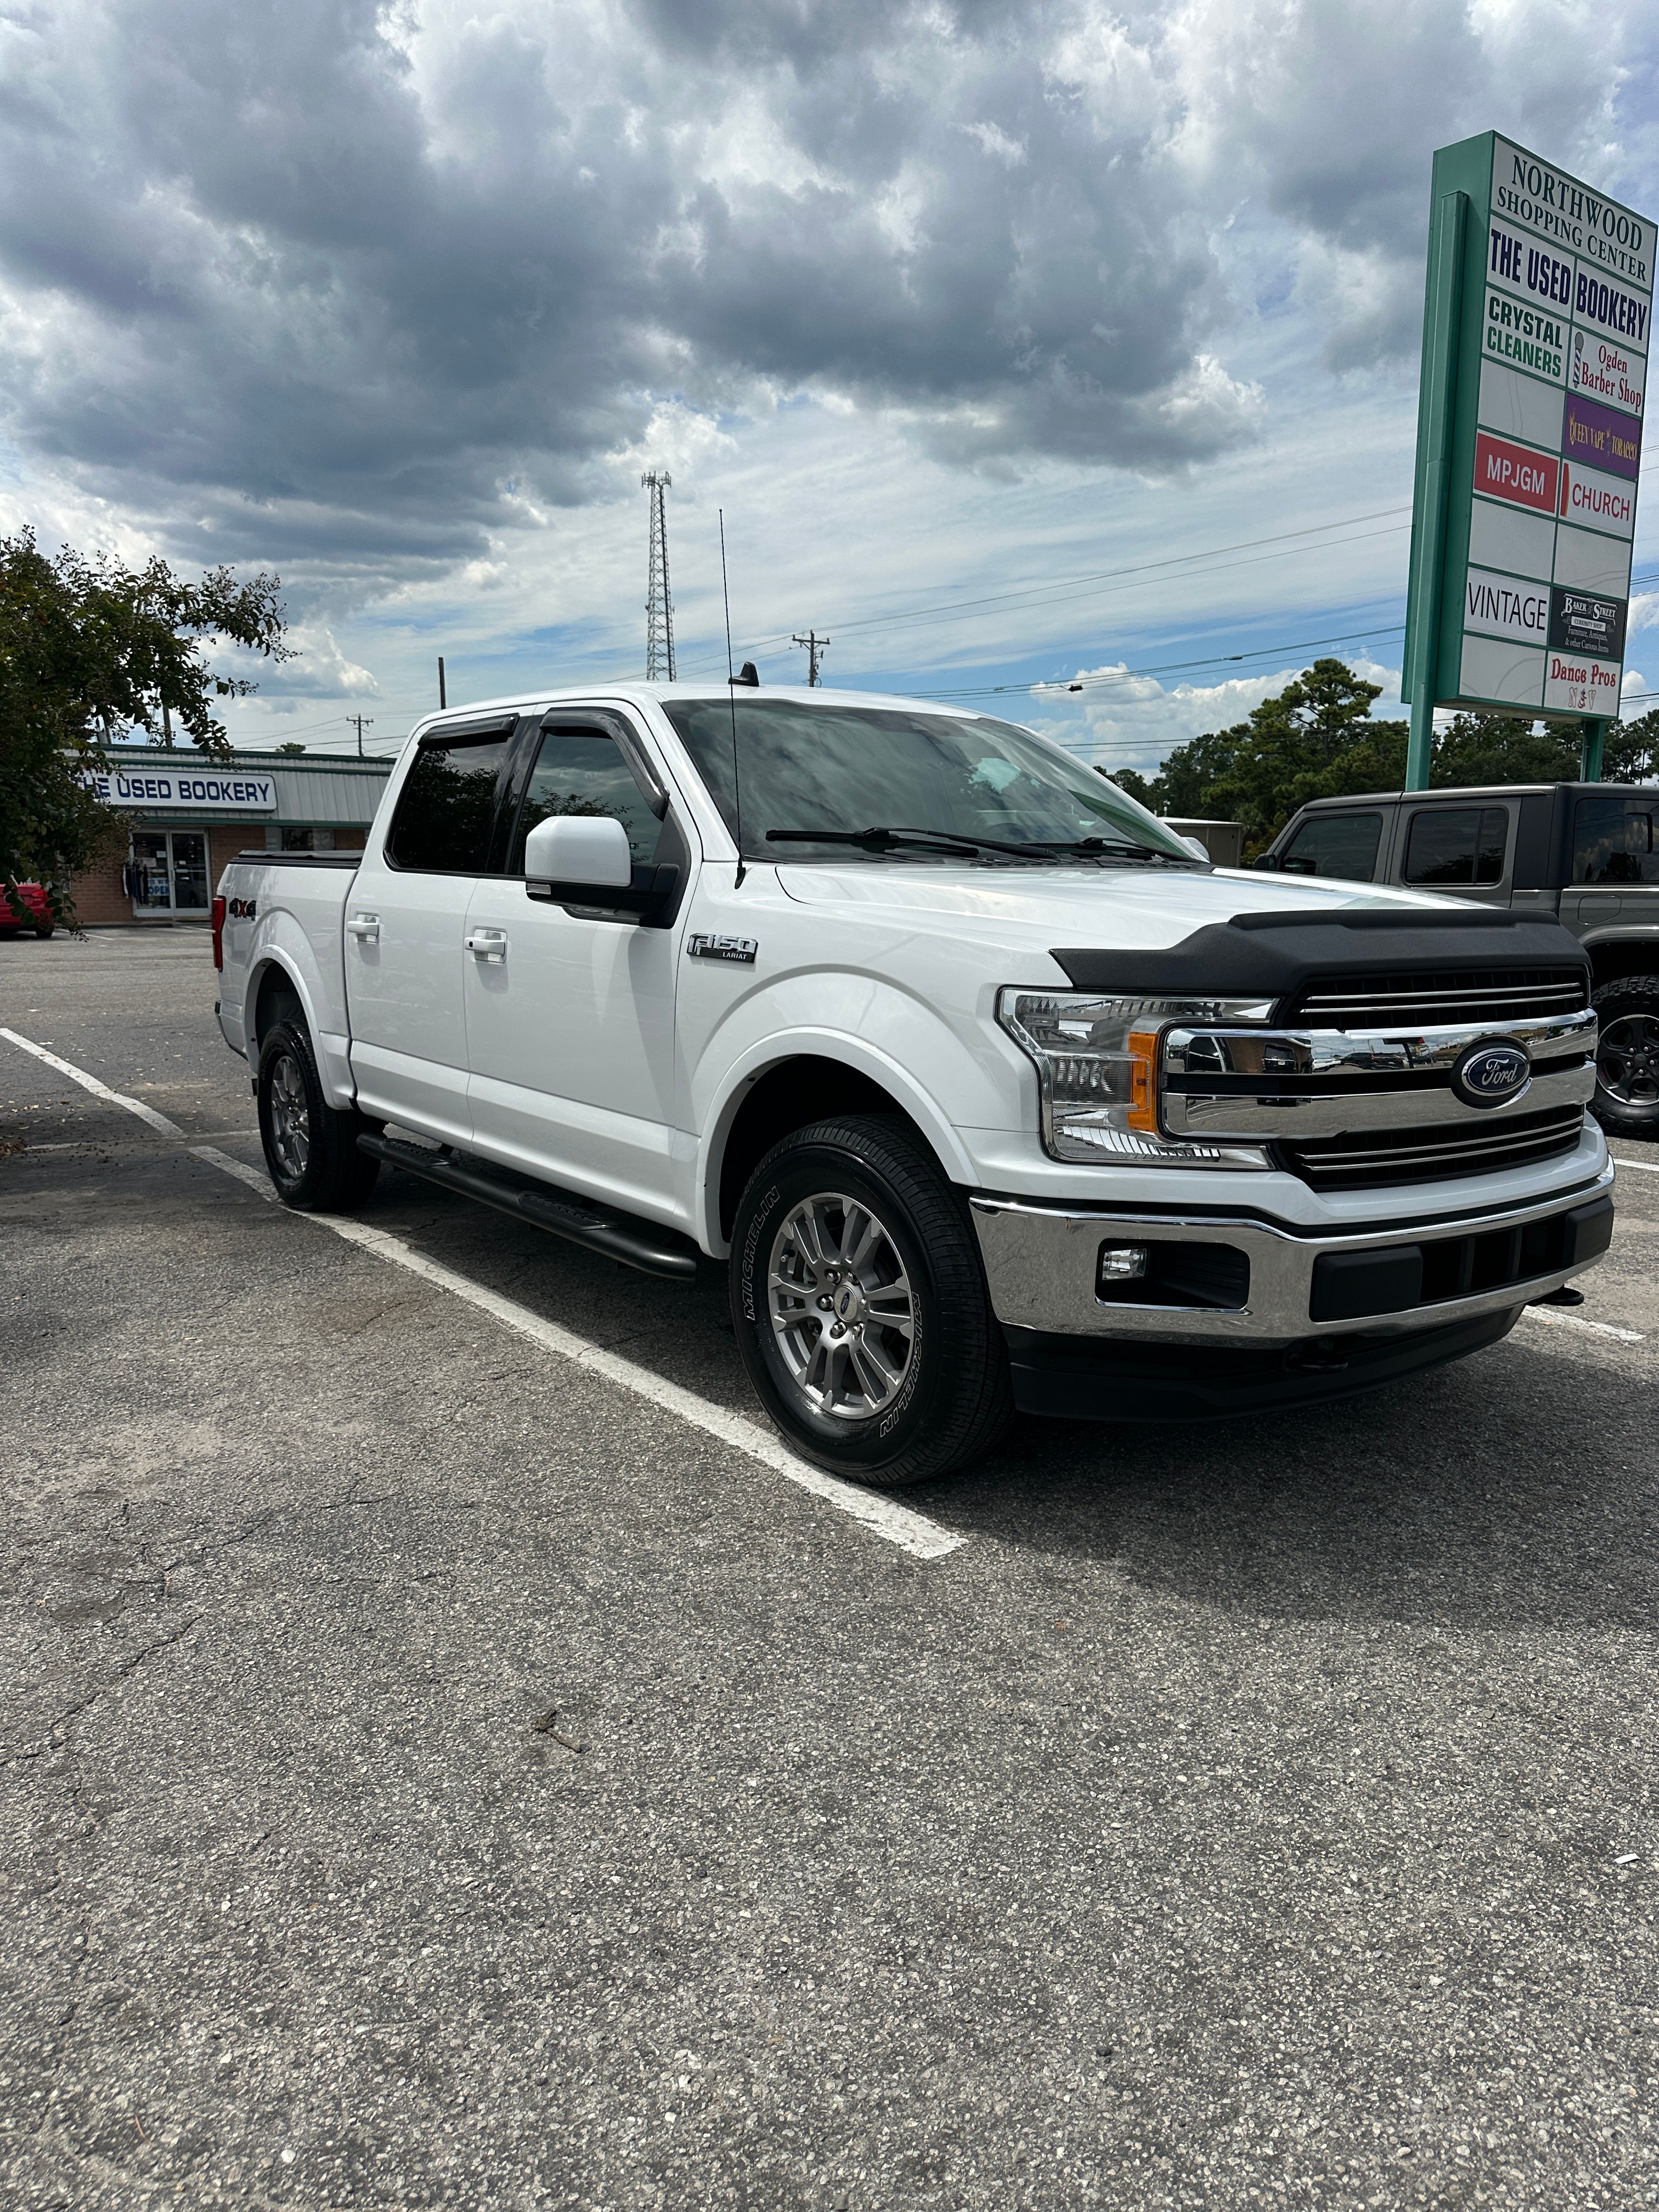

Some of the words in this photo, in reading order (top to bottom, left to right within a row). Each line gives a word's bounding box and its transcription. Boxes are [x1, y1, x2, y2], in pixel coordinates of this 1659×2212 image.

[1511, 154, 1643, 251] NORTHWOOD
[1497, 185, 1582, 247] SHOPPING
[1587, 235, 1646, 281] CENTER
[1491, 228, 1522, 284] THE
[1527, 247, 1571, 305] USED
[1576, 272, 1647, 341] BOOKERY
[1489, 296, 1562, 349] CRYSTAL
[1487, 325, 1561, 377] CLEANERS
[1599, 345, 1627, 374] Ogden
[1581, 362, 1615, 396] Barber
[1618, 377, 1641, 413] Shop
[1570, 420, 1589, 445] QUEEN
[1590, 428, 1605, 450] VAPE
[1612, 435, 1637, 461] TOBACCO
[1487, 454, 1545, 495] MPJGM
[1572, 483, 1630, 521] CHURCH
[1468, 582, 1547, 630] VINTAGE
[1550, 658, 1587, 684] Dance
[1590, 664, 1616, 687] Pros
[117, 778, 172, 799] USED
[178, 780, 270, 802] BOOKERY
[722, 951, 748, 960] LARIAT
[1481, 1058, 1518, 1086] Ford
[742, 1186, 781, 1321] MICHELIN
[880, 1291, 923, 1438] MICHELIN
